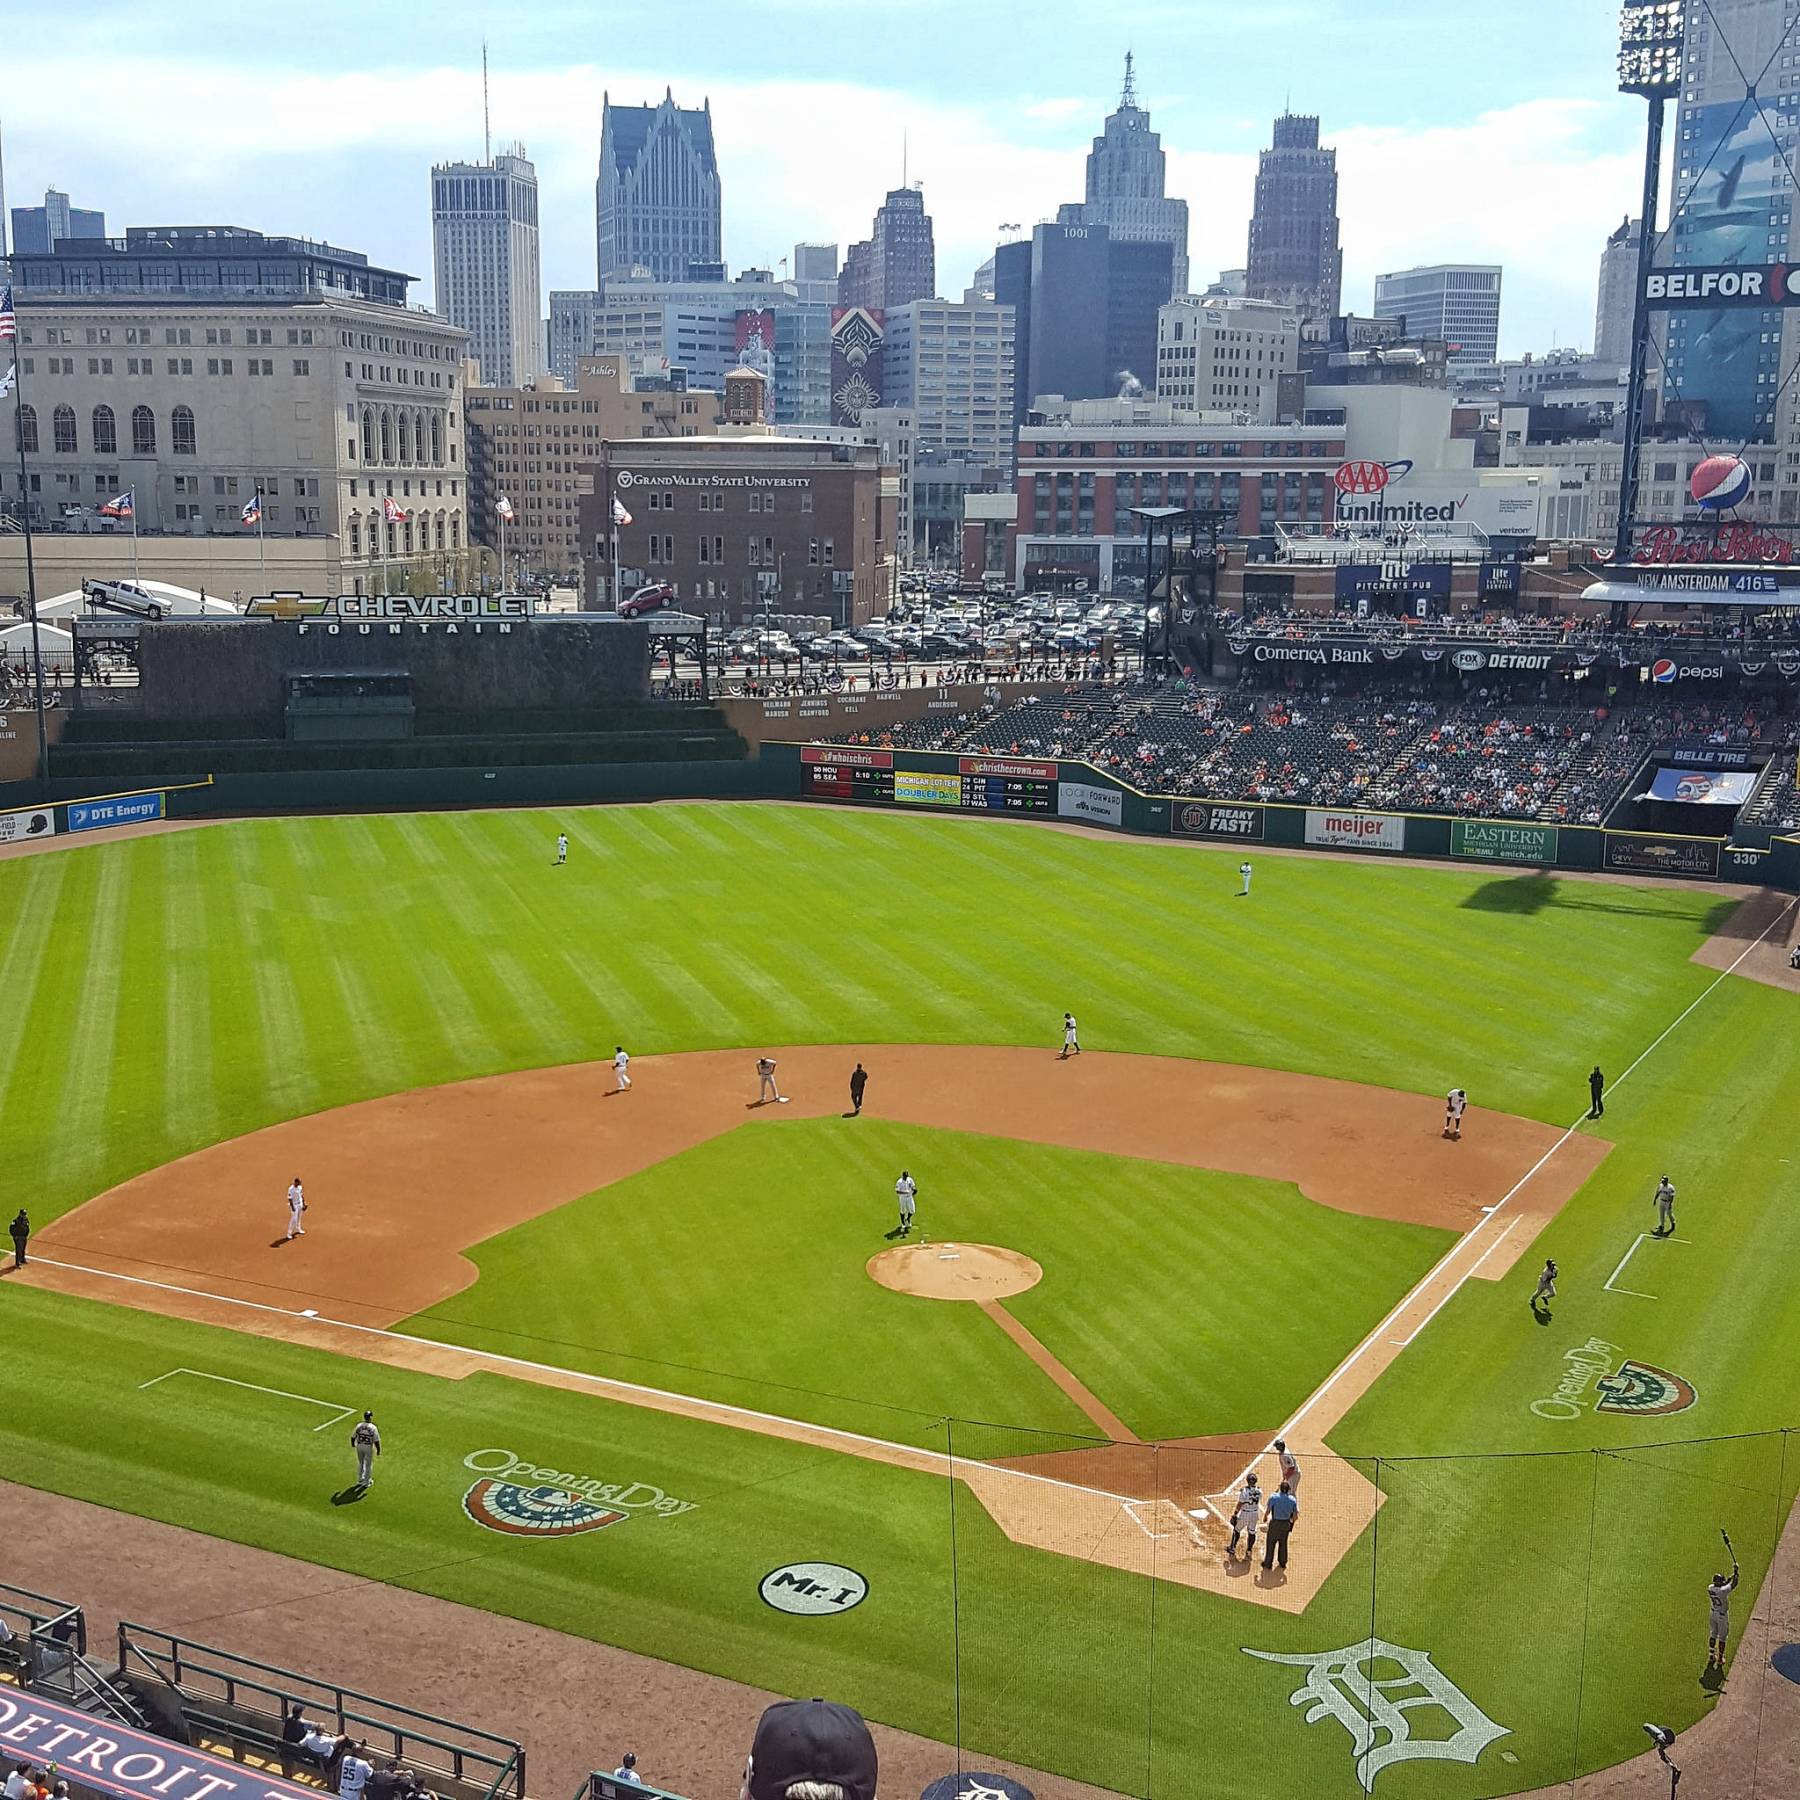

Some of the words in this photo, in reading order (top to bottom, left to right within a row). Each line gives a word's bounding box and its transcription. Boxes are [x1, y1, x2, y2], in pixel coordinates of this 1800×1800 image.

[1063, 227, 1089, 239] 1001
[1646, 271, 1763, 299] BELFOR
[587, 365, 617, 378] Ashley
[1337, 462, 1385, 494] AAA
[1338, 500, 1456, 522] unlimited
[1499, 526, 1528, 534] verizon
[1379, 560, 1411, 582] Lite
[1356, 581, 1408, 590] PITCHER'S
[1412, 581, 1431, 590] PUB
[1637, 574, 1660, 589] NEW
[1660, 574, 1729, 591] AMSTERDAM
[1736, 576, 1762, 591] 416
[336, 595, 542, 618] CHEVROLET
[298, 623, 512, 635] FOUNTAIN
[1331, 648, 1374, 664] Bank
[1488, 653, 1552, 669] DETROIT
[1679, 665, 1724, 680] pepsi
[938, 688, 948, 700] 11
[1674, 750, 1714, 762] BELLE
[1717, 752, 1747, 764] TIRE
[978, 761, 1047, 776] christhecrown.com
[1007, 783, 1023, 791] 7:05
[1006, 798, 1022, 806] 7:05
[1089, 790, 1121, 806] FORWARD
[92, 806, 114, 820] DTE
[117, 803, 155, 817] Energy
[1090, 804, 1111, 816] VISION
[1211, 808, 1255, 820] FREAKY
[1209, 818, 1253, 833] FAST!
[1325, 815, 1384, 838] meijer
[1463, 823, 1545, 845] EASTERN
[1500, 850, 1543, 859] emich.edu
[611, 1482, 701, 1517] Day
[770, 1572, 830, 1598] Mr.
[829, 1587, 858, 1605] I
[342, 1766, 356, 1781] 25
